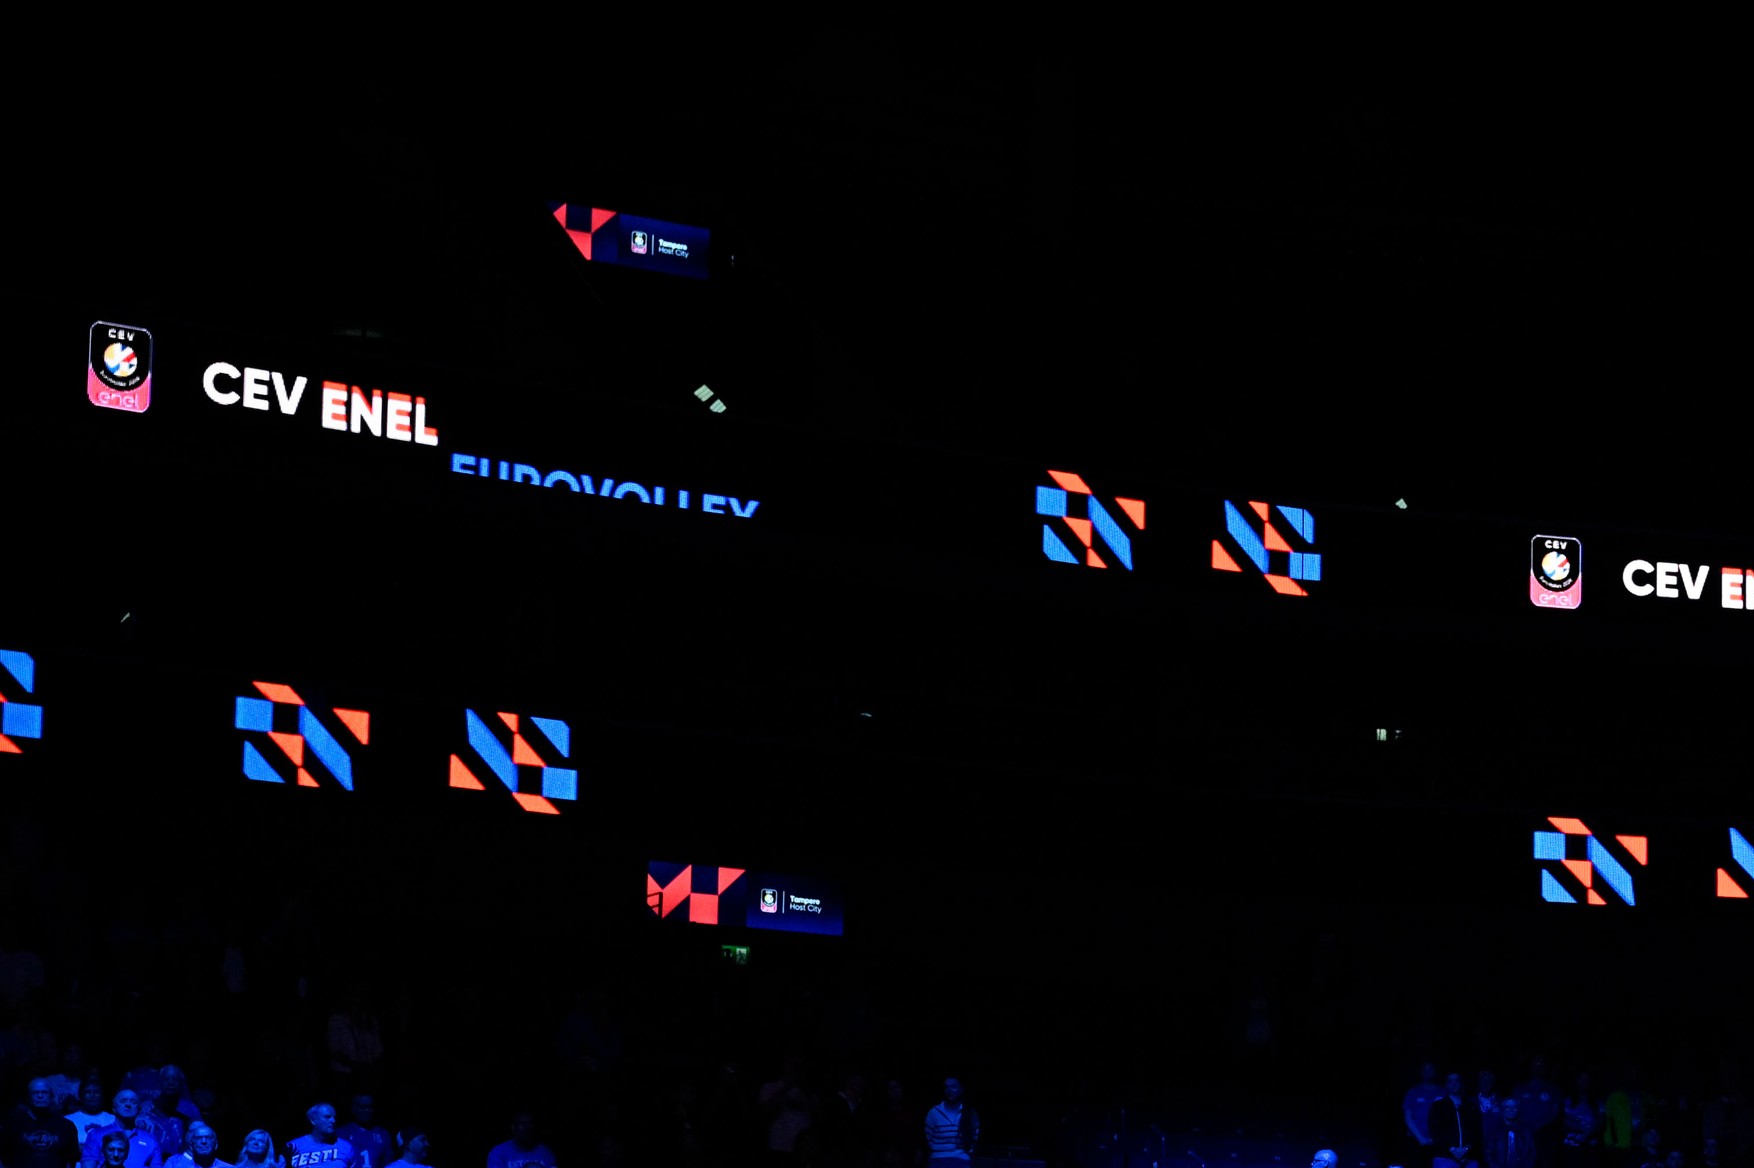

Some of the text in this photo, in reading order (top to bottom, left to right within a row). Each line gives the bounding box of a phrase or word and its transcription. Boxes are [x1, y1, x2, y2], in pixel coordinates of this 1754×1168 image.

[108, 328, 135, 341] CEV
[97, 391, 140, 408] enel
[202, 361, 439, 446] CEV ENEL
[1544, 539, 1567, 550] CEV
[1622, 559, 1709, 600] CEV
[790, 903, 822, 914] Host City
